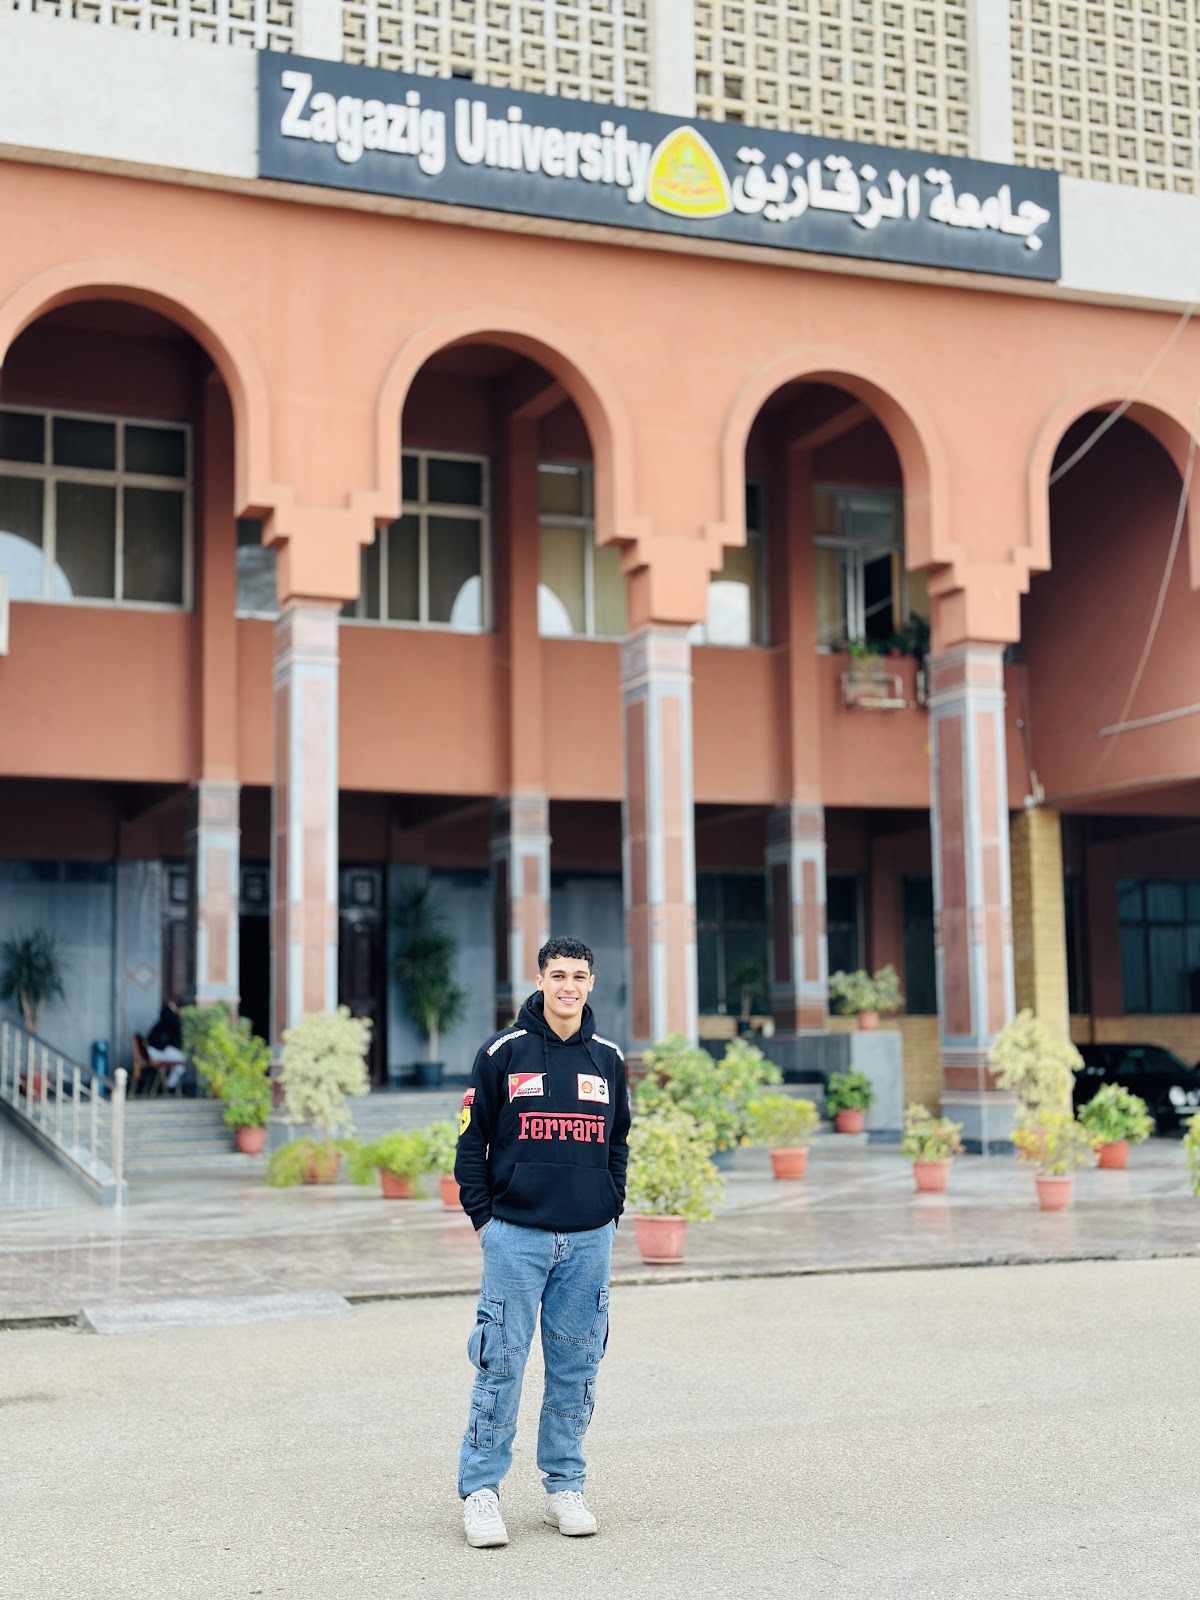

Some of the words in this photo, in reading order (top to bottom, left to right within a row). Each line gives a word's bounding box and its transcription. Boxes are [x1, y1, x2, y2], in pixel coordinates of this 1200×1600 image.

[280, 69, 446, 176] Zagazig
[455, 97, 652, 204] University
[731, 146, 920, 230] الزقازيق
[924, 167, 1051, 251] جامعة
[518, 1112, 605, 1143] Ferrari
